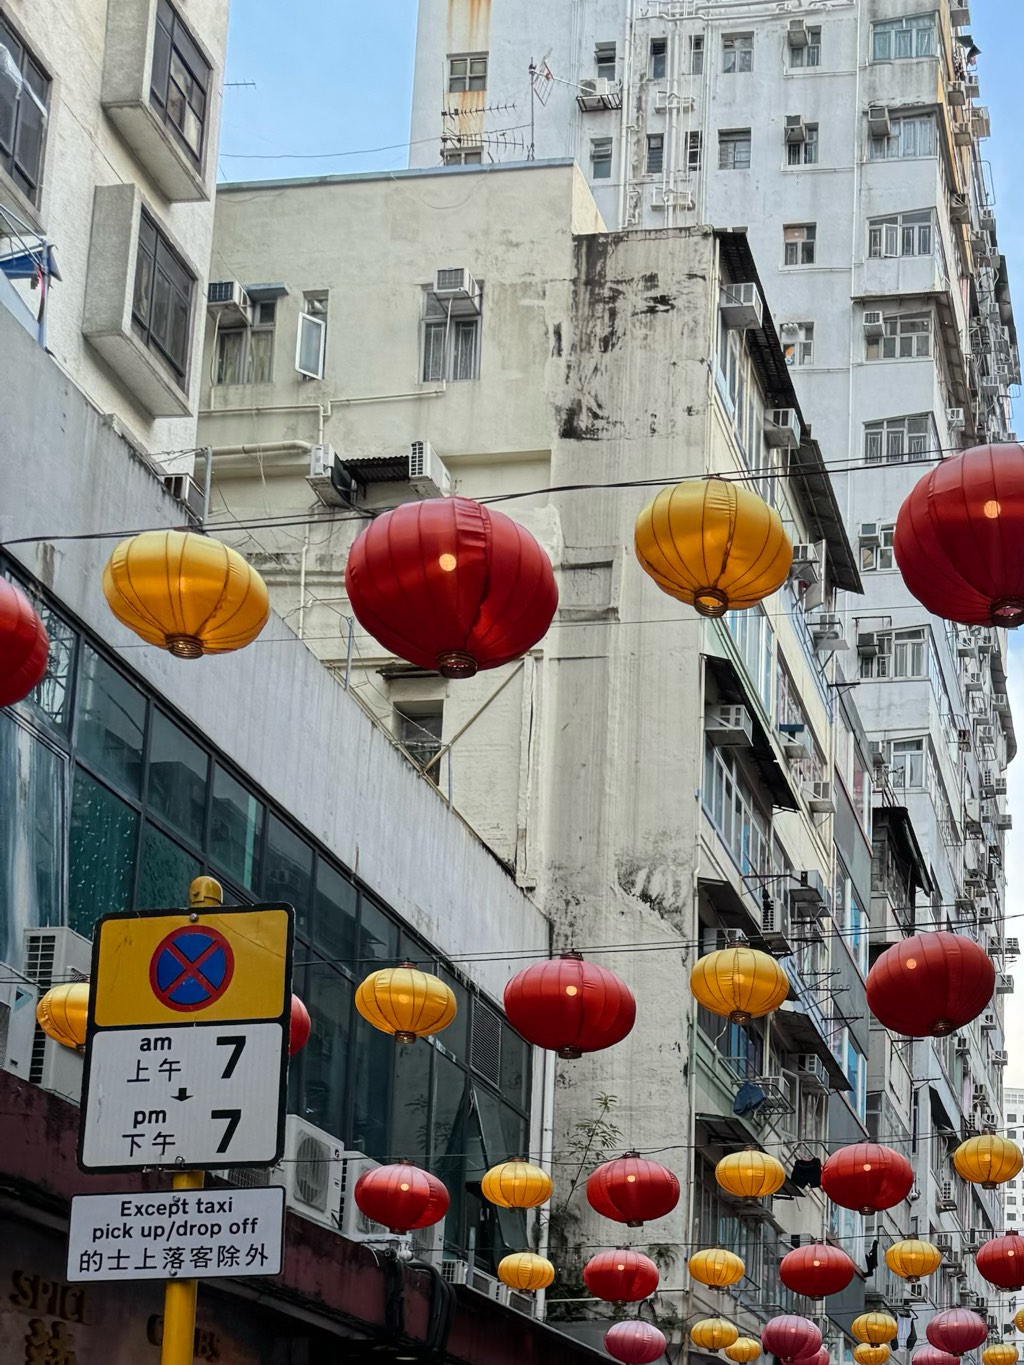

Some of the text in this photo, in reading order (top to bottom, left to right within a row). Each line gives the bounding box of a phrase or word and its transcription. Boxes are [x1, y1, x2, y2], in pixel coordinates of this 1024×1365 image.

[139, 1035, 247, 1079] am 7
[126, 1058, 182, 1083] 上午
[133, 1109, 242, 1154] pm 7
[122, 1132, 176, 1157] 下午
[120, 1197, 233, 1218] Except taxi
[92, 1218, 259, 1243] pick up/drop off
[79, 1243, 269, 1273] 的士上落客除外
